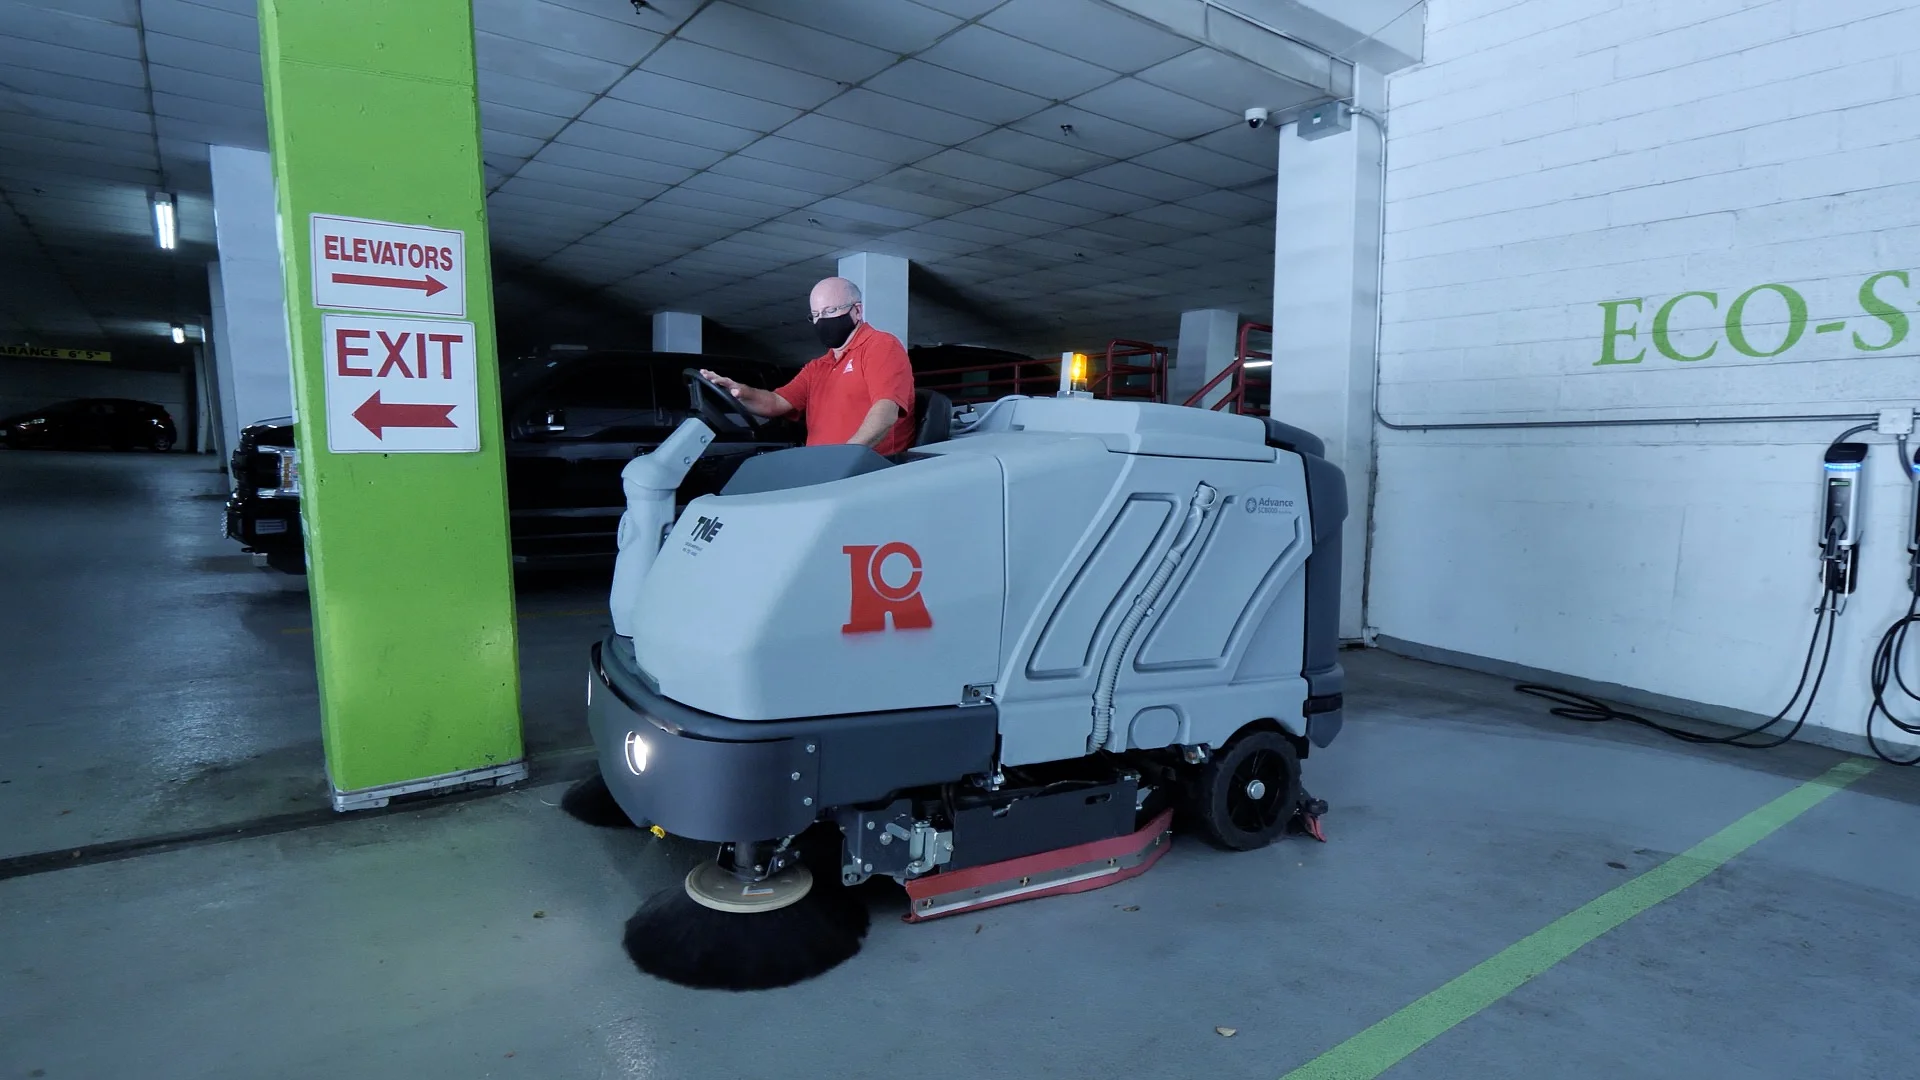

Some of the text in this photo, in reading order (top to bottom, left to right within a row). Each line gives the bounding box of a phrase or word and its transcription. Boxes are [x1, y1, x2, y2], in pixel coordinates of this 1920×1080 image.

[324, 235, 453, 271] ELEVATORS
[1592, 269, 1920, 366] ECO-S
[336, 328, 463, 379] EXIT
[1258, 497, 1294, 507] Advance
